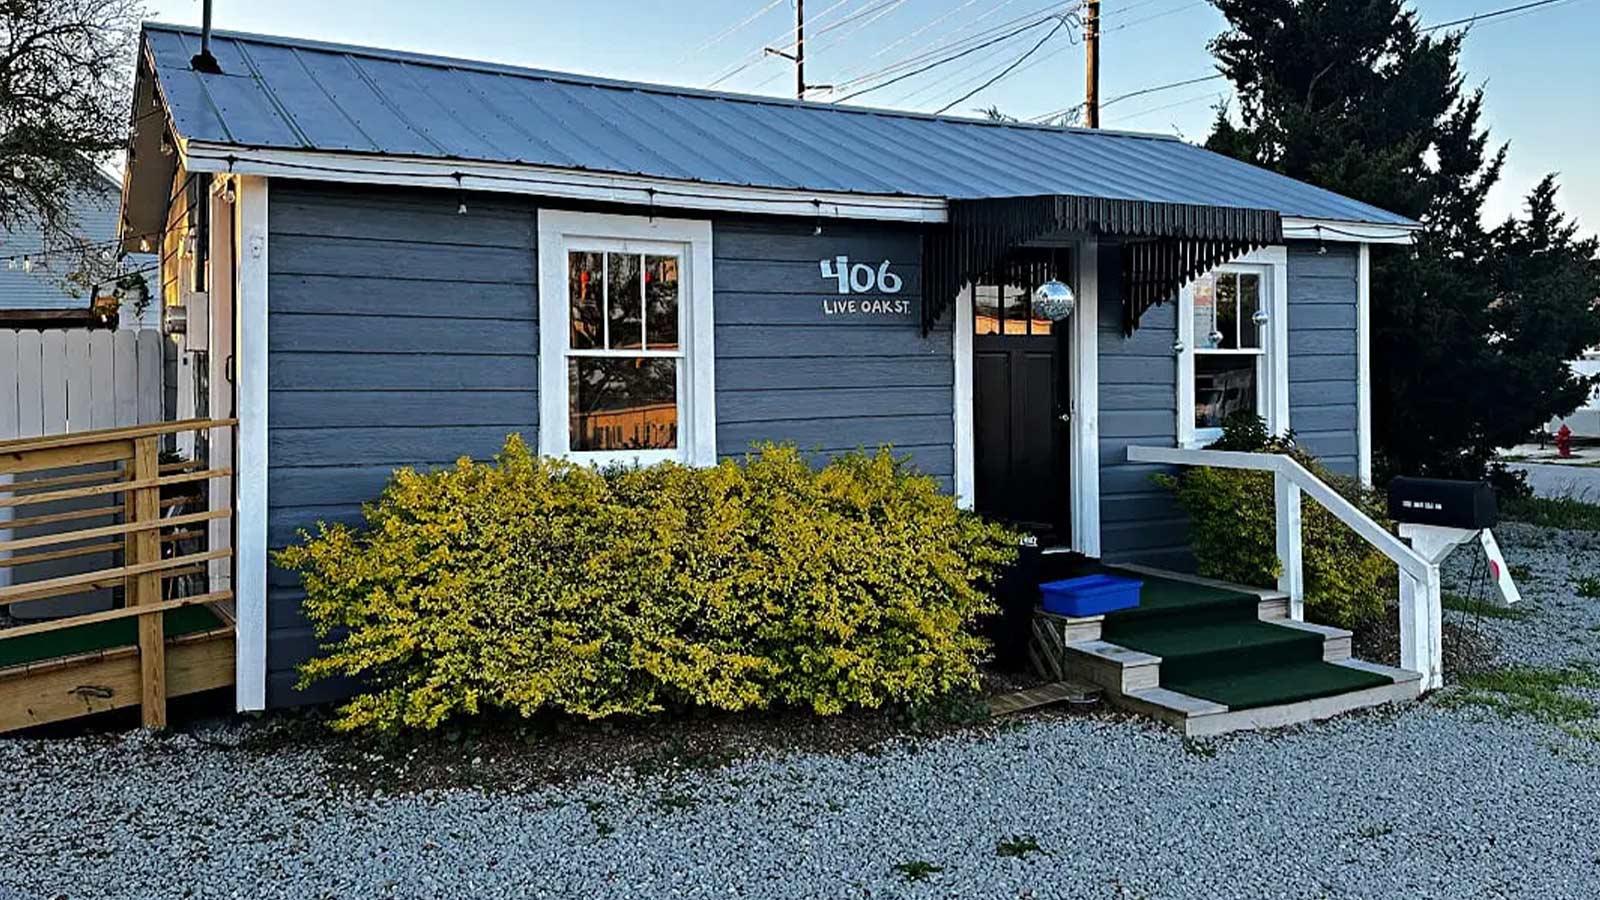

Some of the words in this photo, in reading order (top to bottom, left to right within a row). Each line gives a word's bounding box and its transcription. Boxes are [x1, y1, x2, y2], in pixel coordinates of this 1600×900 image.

[820, 255, 903, 294] 406
[823, 299, 857, 314] LIVE
[860, 299, 893, 314] OAK
